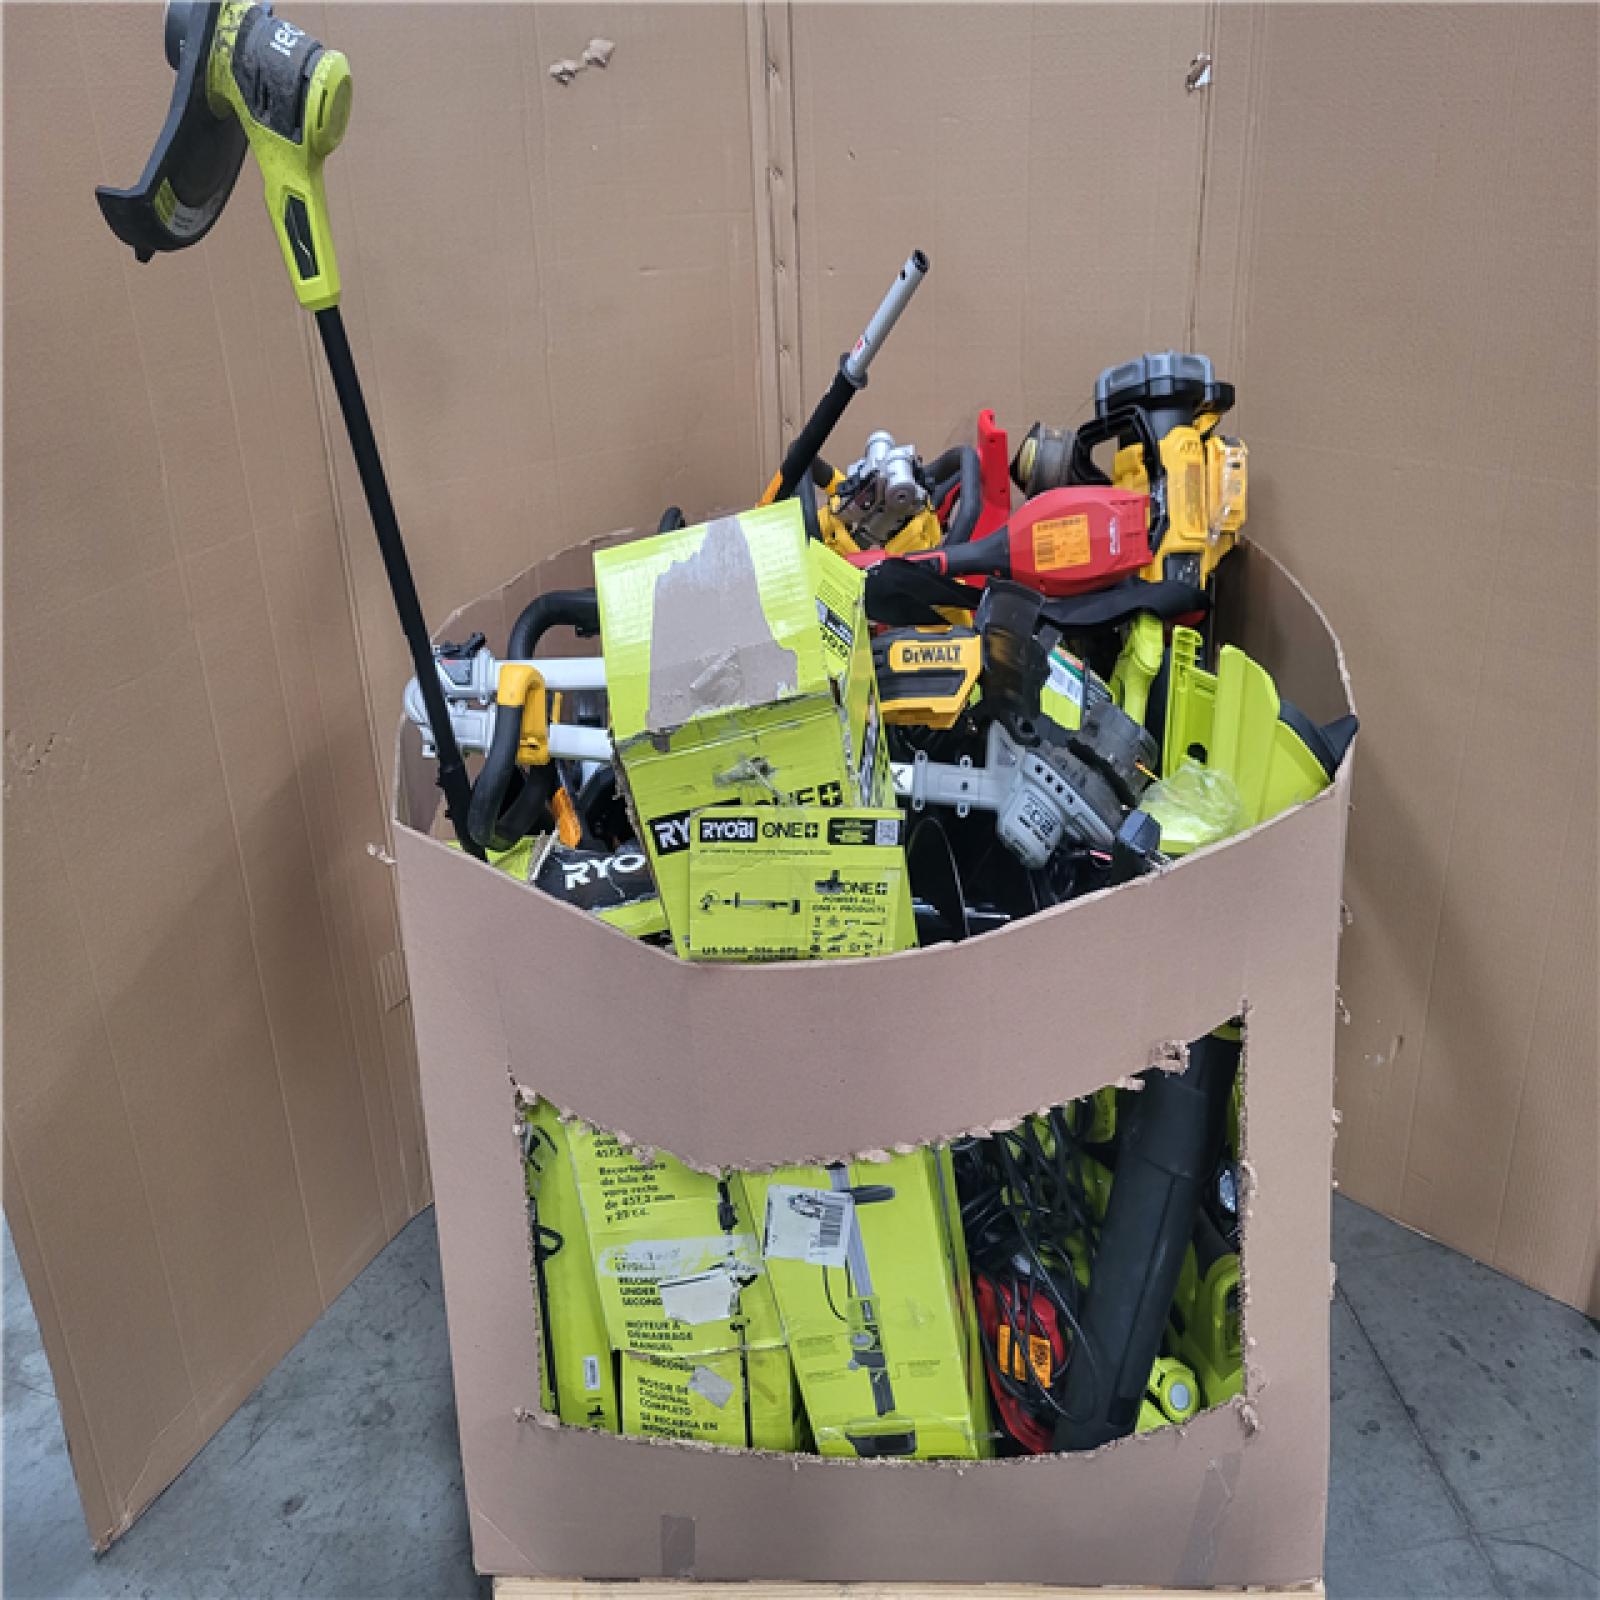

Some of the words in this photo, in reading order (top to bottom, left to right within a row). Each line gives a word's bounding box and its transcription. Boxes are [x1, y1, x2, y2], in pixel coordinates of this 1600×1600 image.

[701, 821, 756, 839] RYOBI
[761, 821, 818, 838] ONE+
[562, 855, 646, 891] RYO
